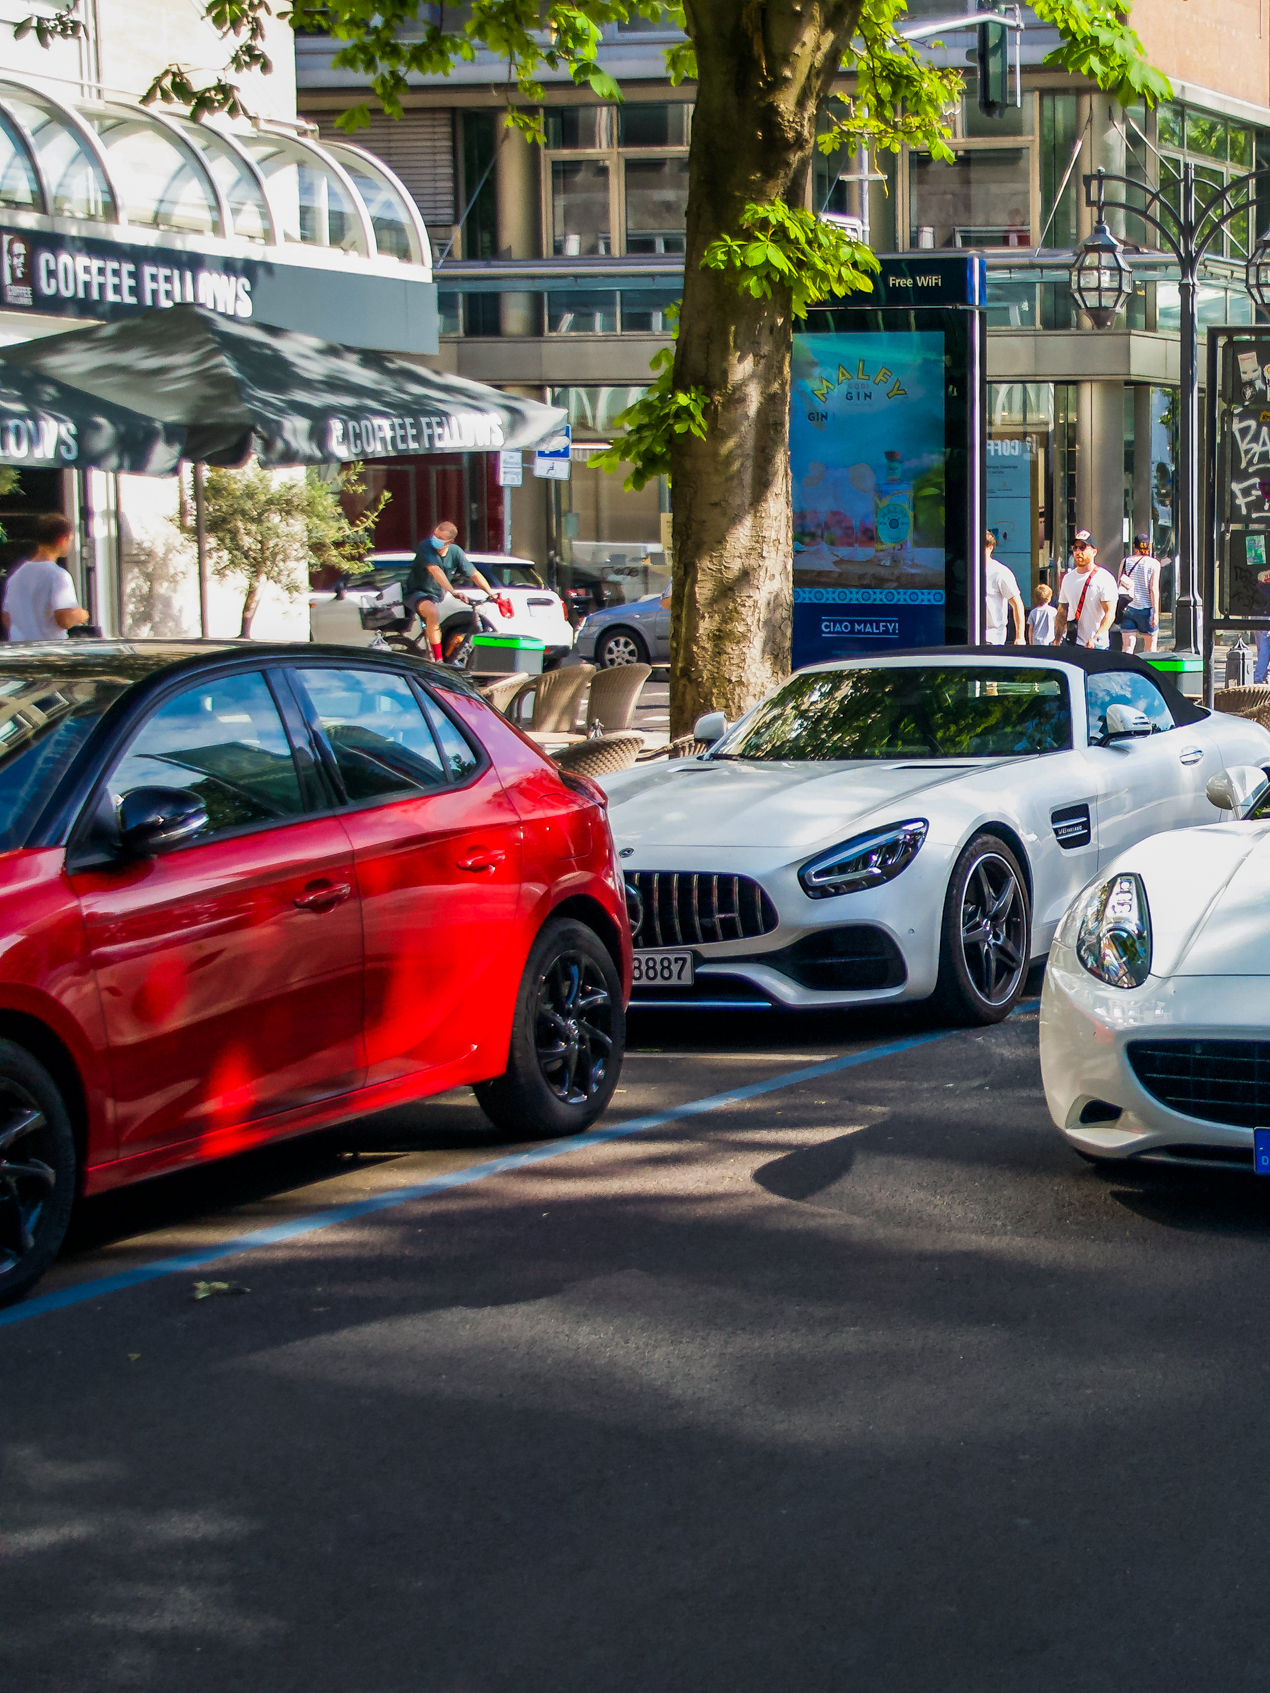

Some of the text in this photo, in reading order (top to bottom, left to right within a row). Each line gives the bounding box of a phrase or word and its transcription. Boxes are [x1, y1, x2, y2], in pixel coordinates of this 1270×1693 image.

[38, 252, 253, 318] COFFEE FELLOWS
[889, 275, 942, 288] Free WiFi
[811, 358, 908, 404] MALFY
[845, 391, 873, 401] GIN
[807, 411, 829, 422] GIN
[349, 413, 505, 455] COFFEE FELLOWS
[821, 621, 899, 633] CIAO MALFY!
[633, 956, 688, 981] 8887
[1261, 1155, 1270, 1165] D
